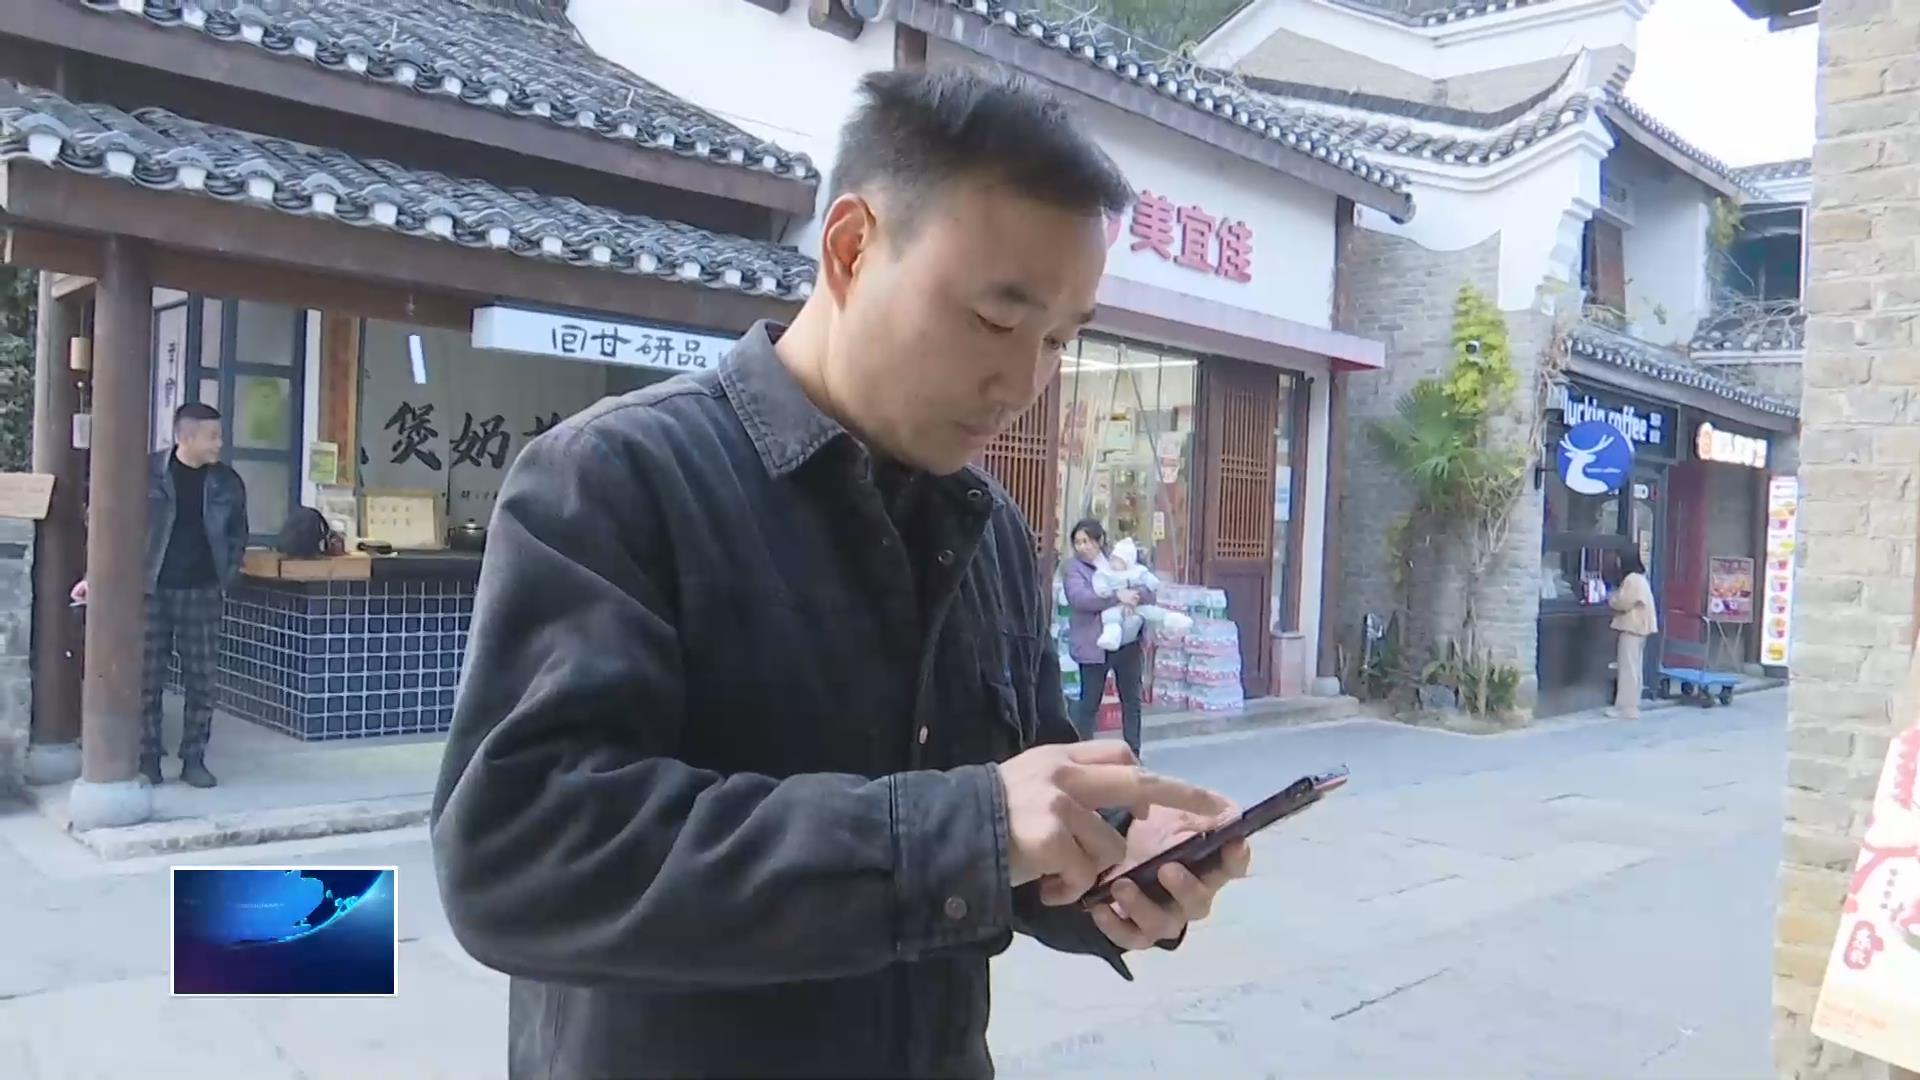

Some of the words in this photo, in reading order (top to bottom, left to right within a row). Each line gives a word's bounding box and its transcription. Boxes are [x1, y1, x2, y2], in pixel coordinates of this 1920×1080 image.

[1130, 189, 1253, 284] 美宜佳
[552, 325, 726, 368] 回甘研品
[384, 401, 560, 471] 煲奶
